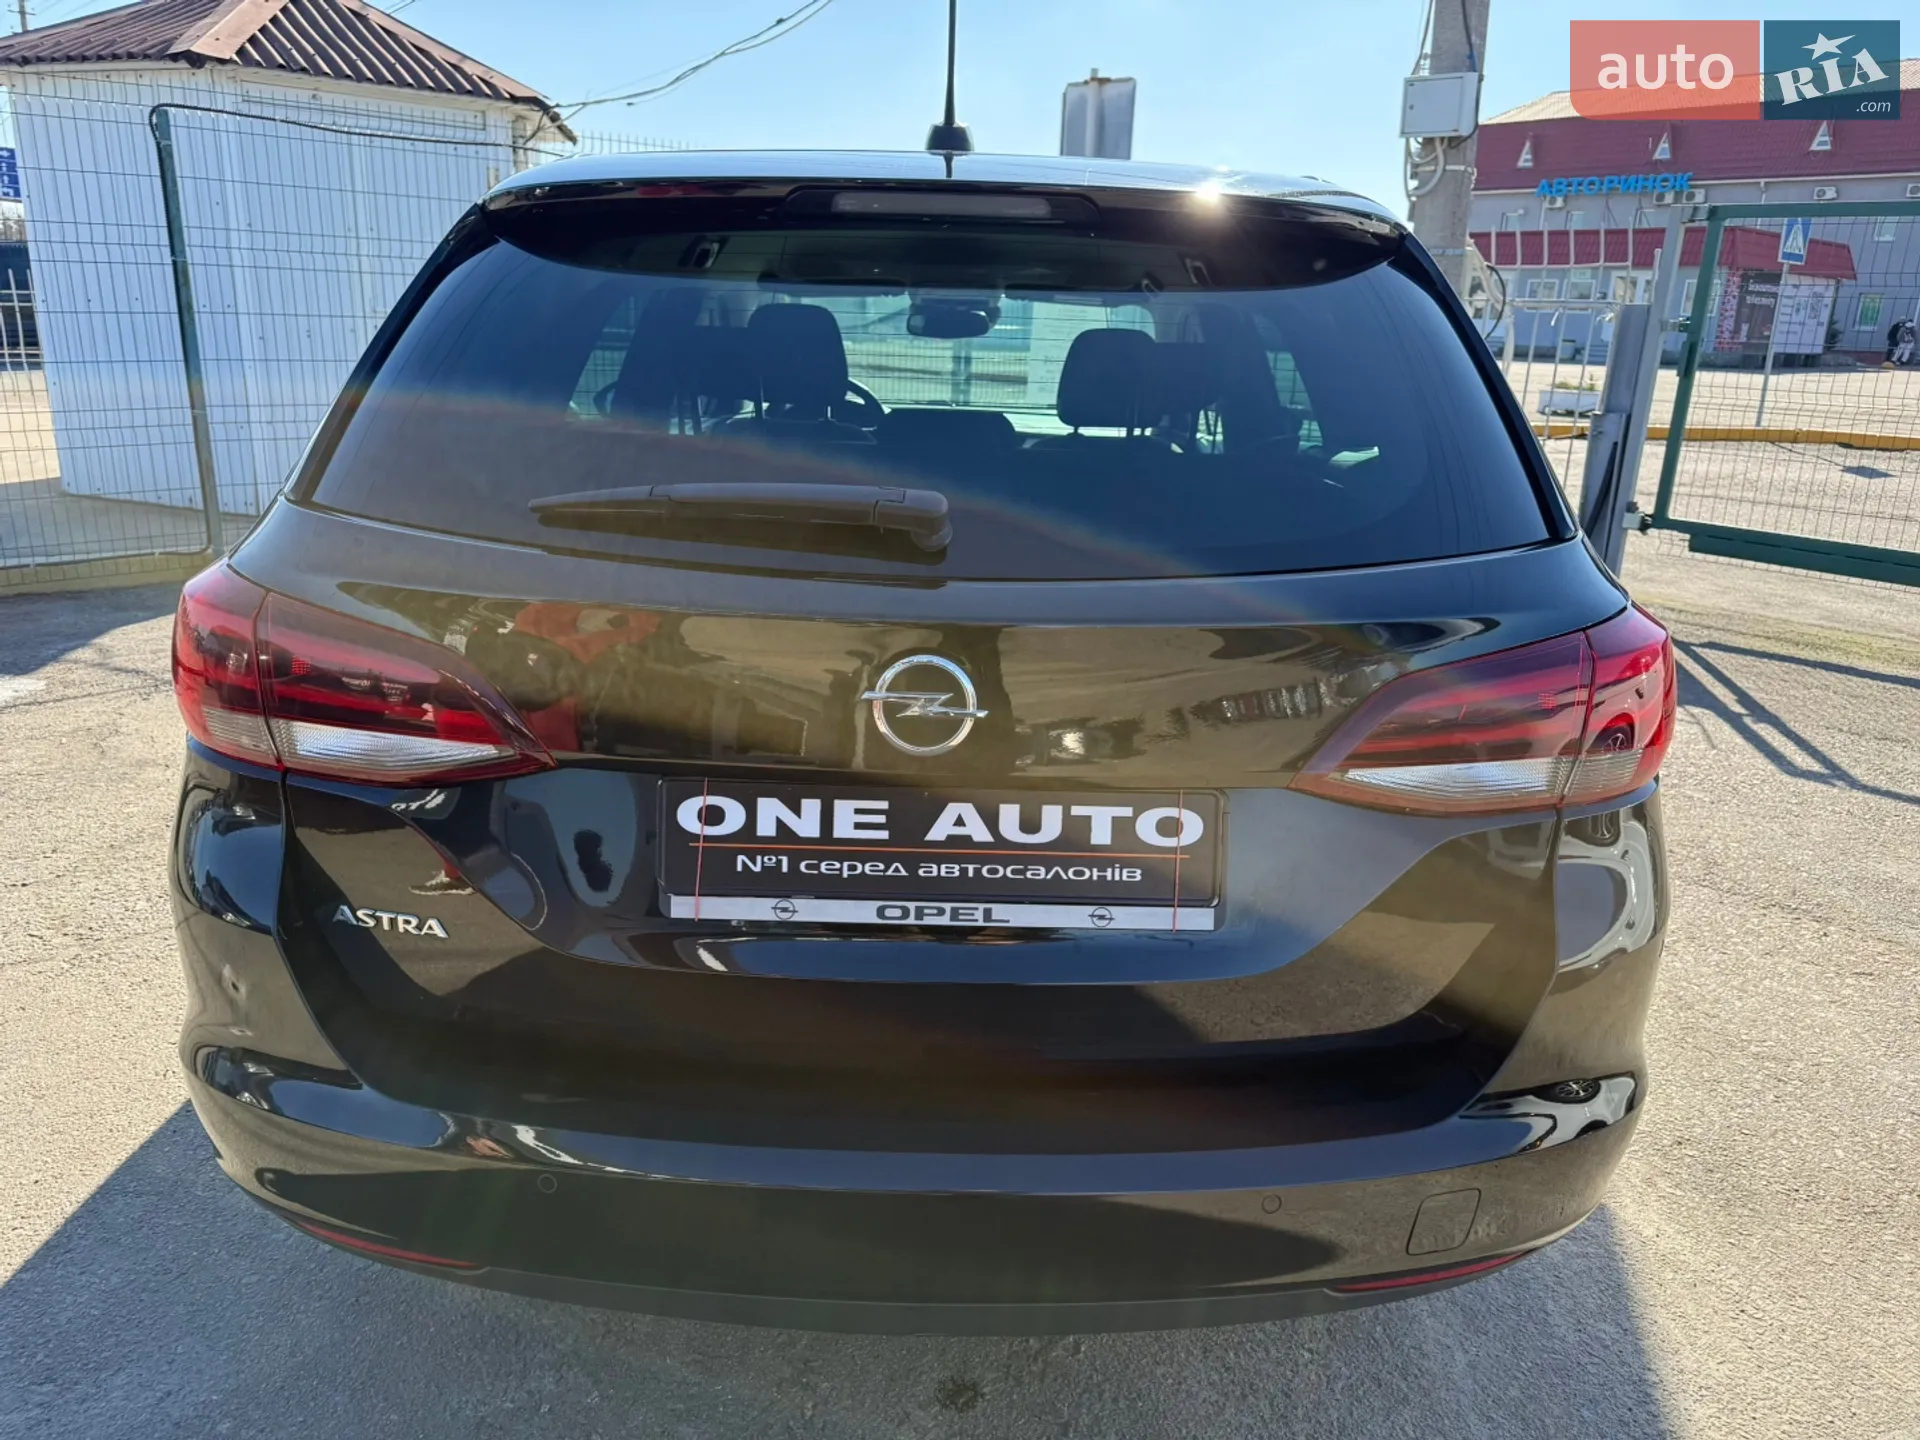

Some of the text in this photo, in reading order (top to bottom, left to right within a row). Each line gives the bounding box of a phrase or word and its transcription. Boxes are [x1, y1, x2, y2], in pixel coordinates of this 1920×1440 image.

[1536, 172, 1694, 198] АВТОРИНОК
[676, 795, 1205, 848] ONE AUTO
[799, 859, 909, 879] серед
[917, 862, 1143, 882] автосалонів
[332, 904, 449, 939] ASTRA
[875, 903, 1011, 924] OPEL
